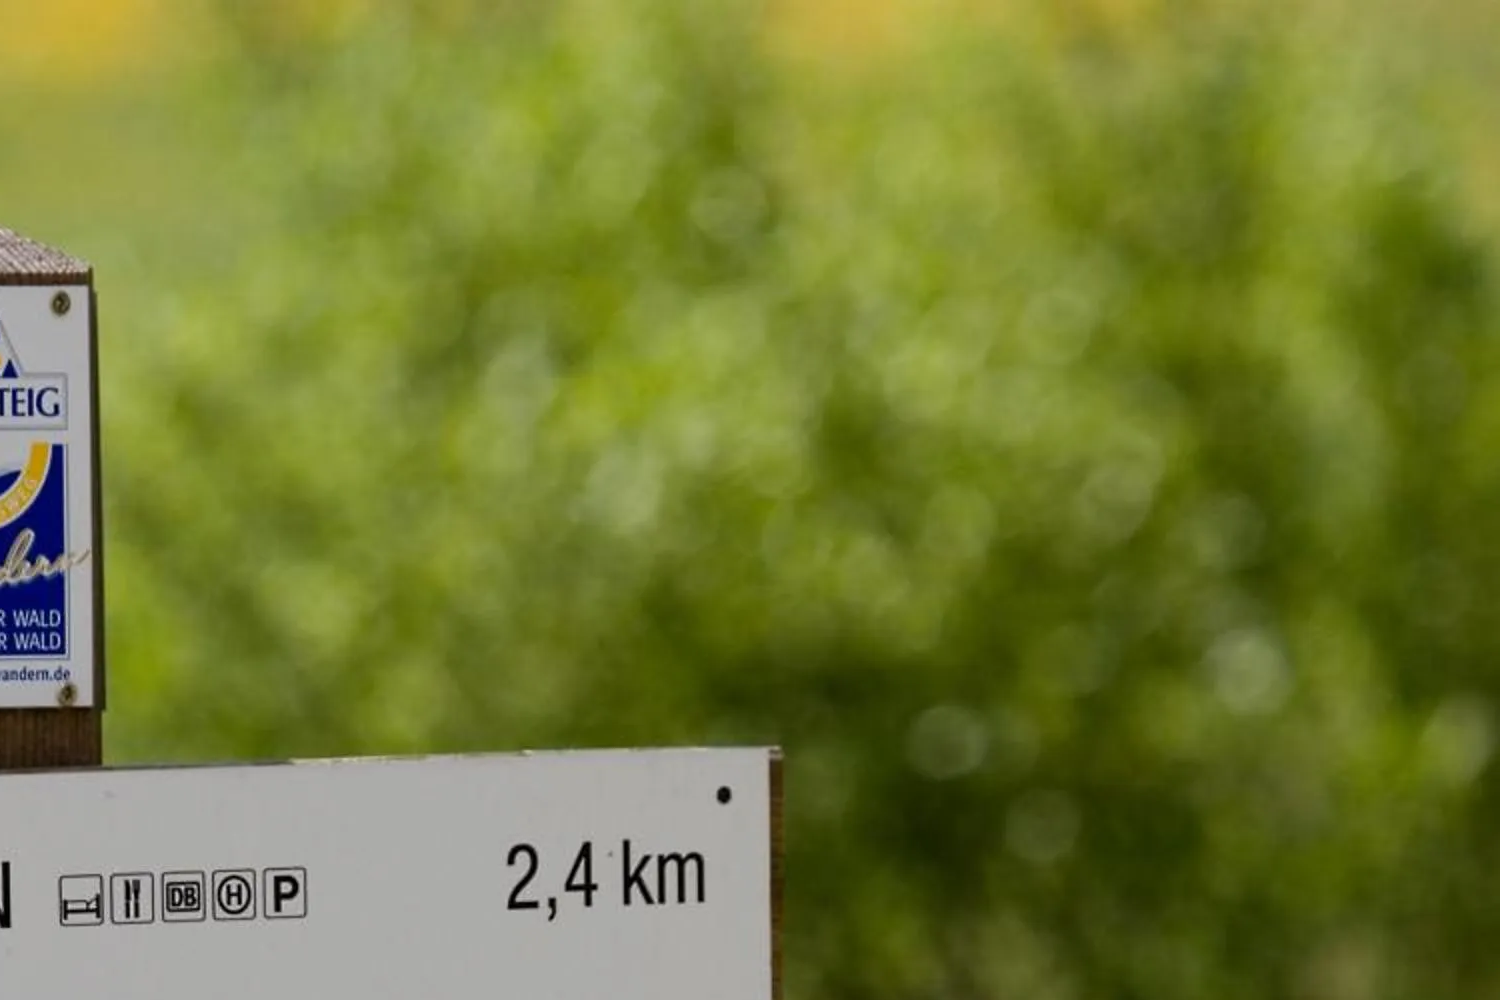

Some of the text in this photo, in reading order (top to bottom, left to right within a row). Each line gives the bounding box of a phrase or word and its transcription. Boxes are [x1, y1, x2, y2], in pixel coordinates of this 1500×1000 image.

[13, 609, 62, 628] WALD
[13, 632, 62, 651] WALD
[274, 875, 300, 913] P
[507, 839, 705, 922] 2,4 km
